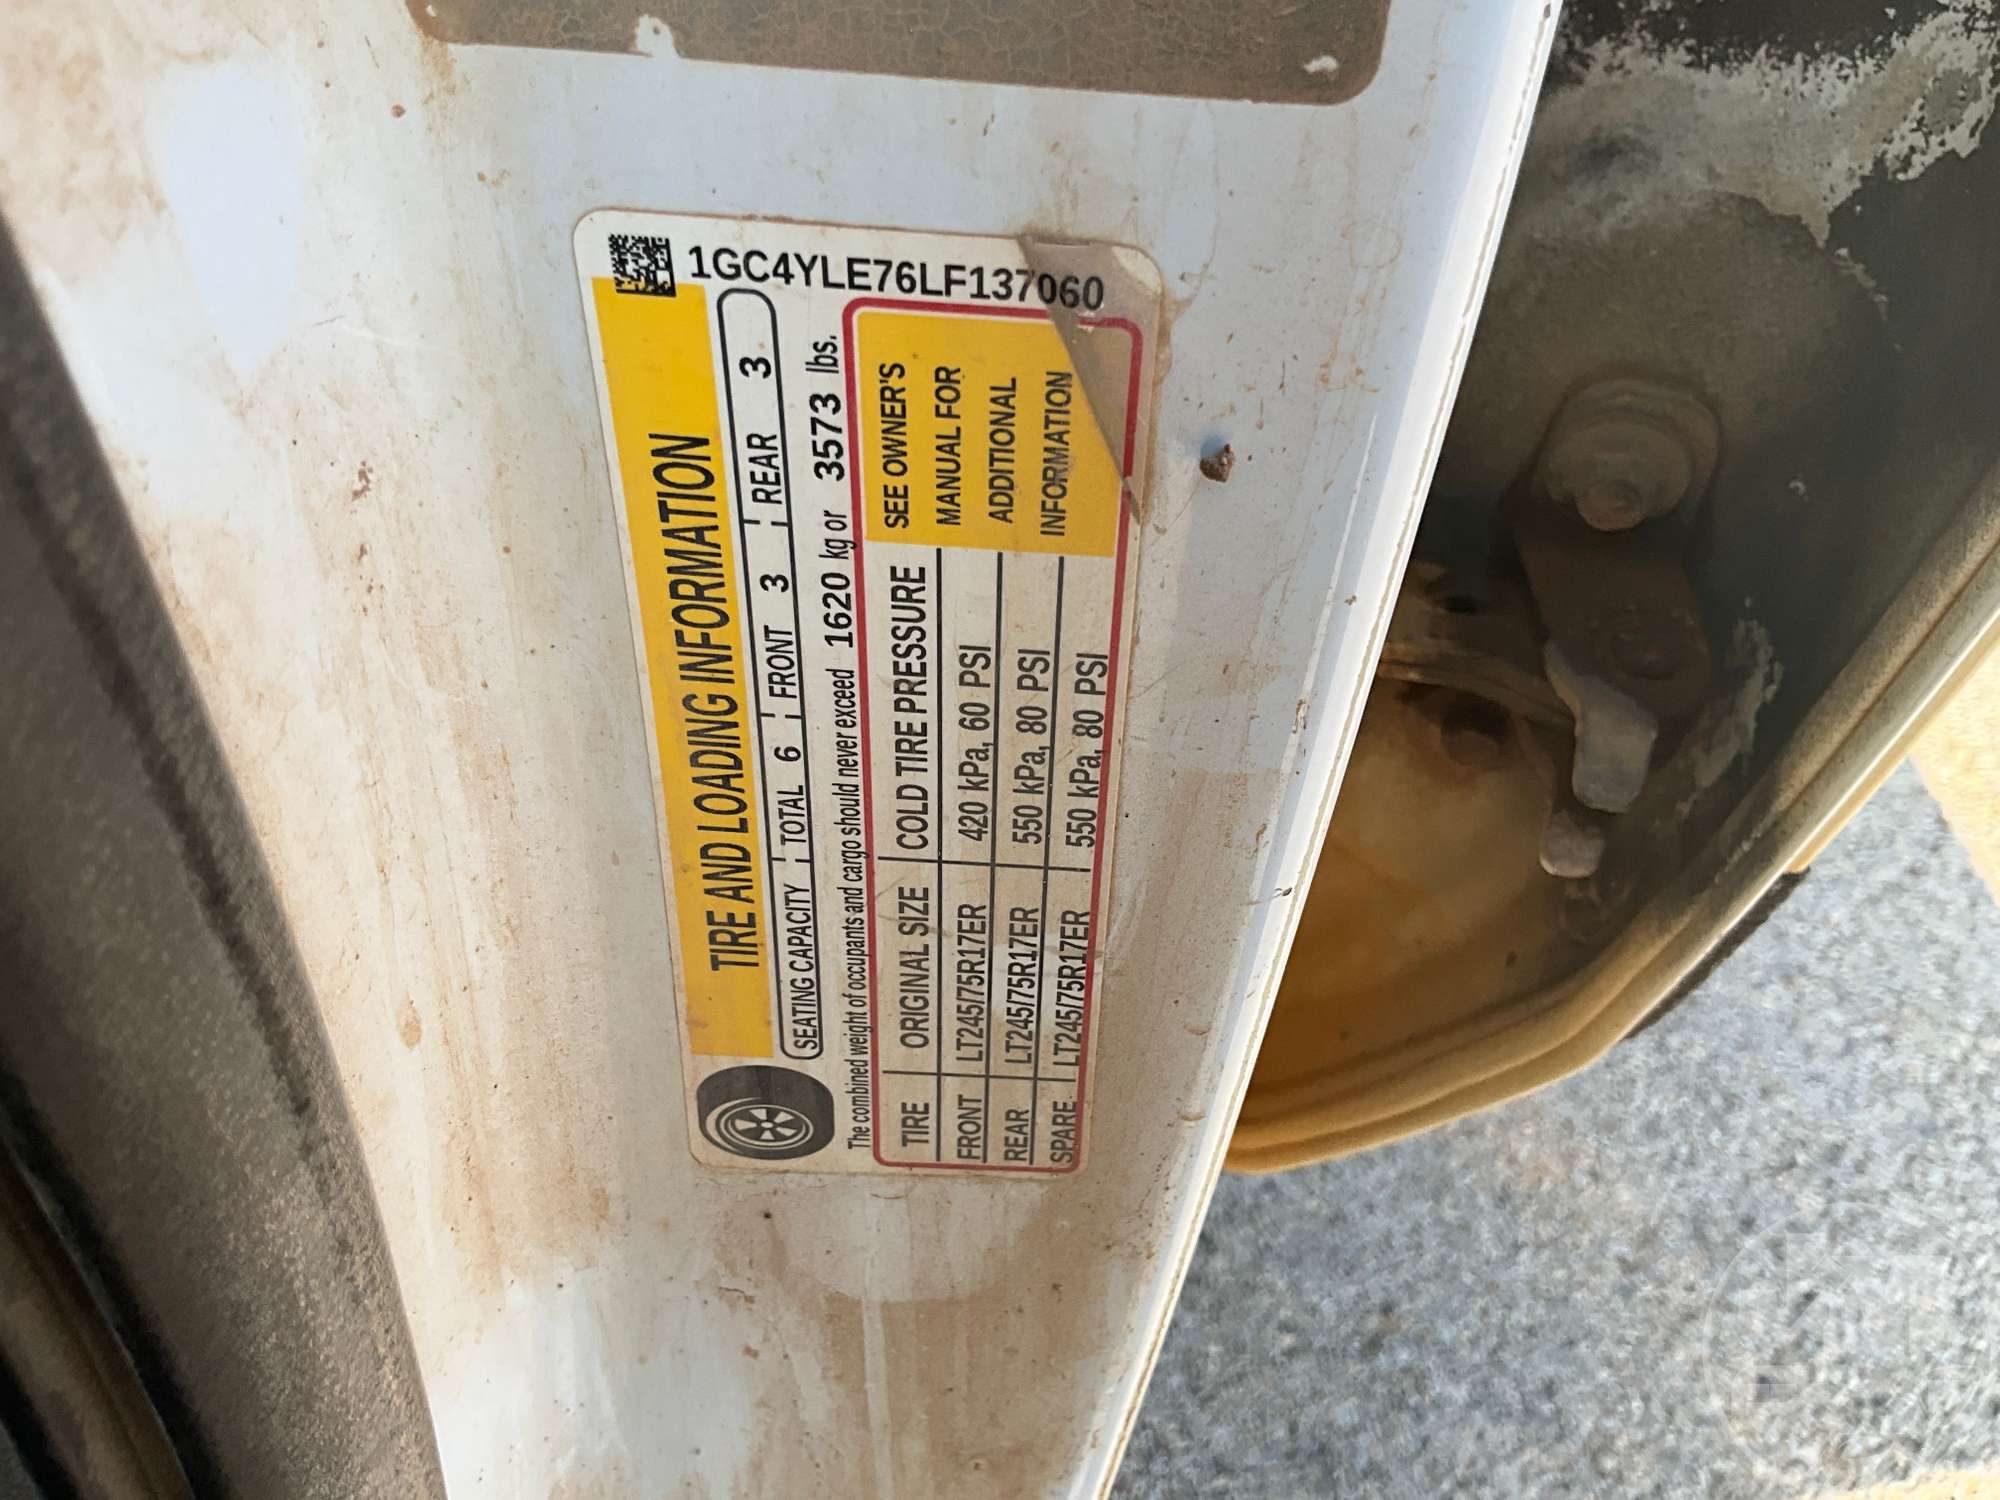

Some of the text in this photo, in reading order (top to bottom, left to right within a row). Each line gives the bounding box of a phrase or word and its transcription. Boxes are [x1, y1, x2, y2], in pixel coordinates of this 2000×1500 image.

[688, 246, 1105, 311] 1GC4YLE76LF137060
[738, 356, 783, 504] REAR 3
[879, 362, 909, 529] SEE OWNER'S
[934, 365, 961, 526] MANUAL FOR
[988, 377, 1016, 524] ADDITIONAL
[1040, 371, 1072, 537] INFORMATION
[648, 433, 760, 971] TIRE AND LOADING INFORMATION
[760, 573, 797, 698] FRONT 3
[890, 565, 928, 850] COLD TIRE PRESSURE
[774, 746, 806, 846] TOTAL 6
[805, 335, 873, 1150] The combined weight of occupants and cargo should never exceed 1620 kg or 3573 lbs.
[957, 645, 993, 842] 420 kPa, 60 PSI
[1012, 649, 1050, 845] 550 kPa, 80 PSI
[1065, 652, 1108, 848] 550 kPa, 80 PSI
[784, 884, 818, 1050] SEATING CAPACITY
[898, 886, 930, 1049] ORIGINAL SIZE
[956, 903, 986, 1062] LT245/75R17ER
[1004, 906, 1039, 1065] LT245/75R17ER
[1052, 909, 1090, 1067] LT245/75R17ER
[901, 1102, 930, 1147] TIRE
[957, 1094, 982, 1160] FRONT
[1004, 1108, 1030, 1162] REAR
[1050, 1101, 1078, 1164] SPARE
